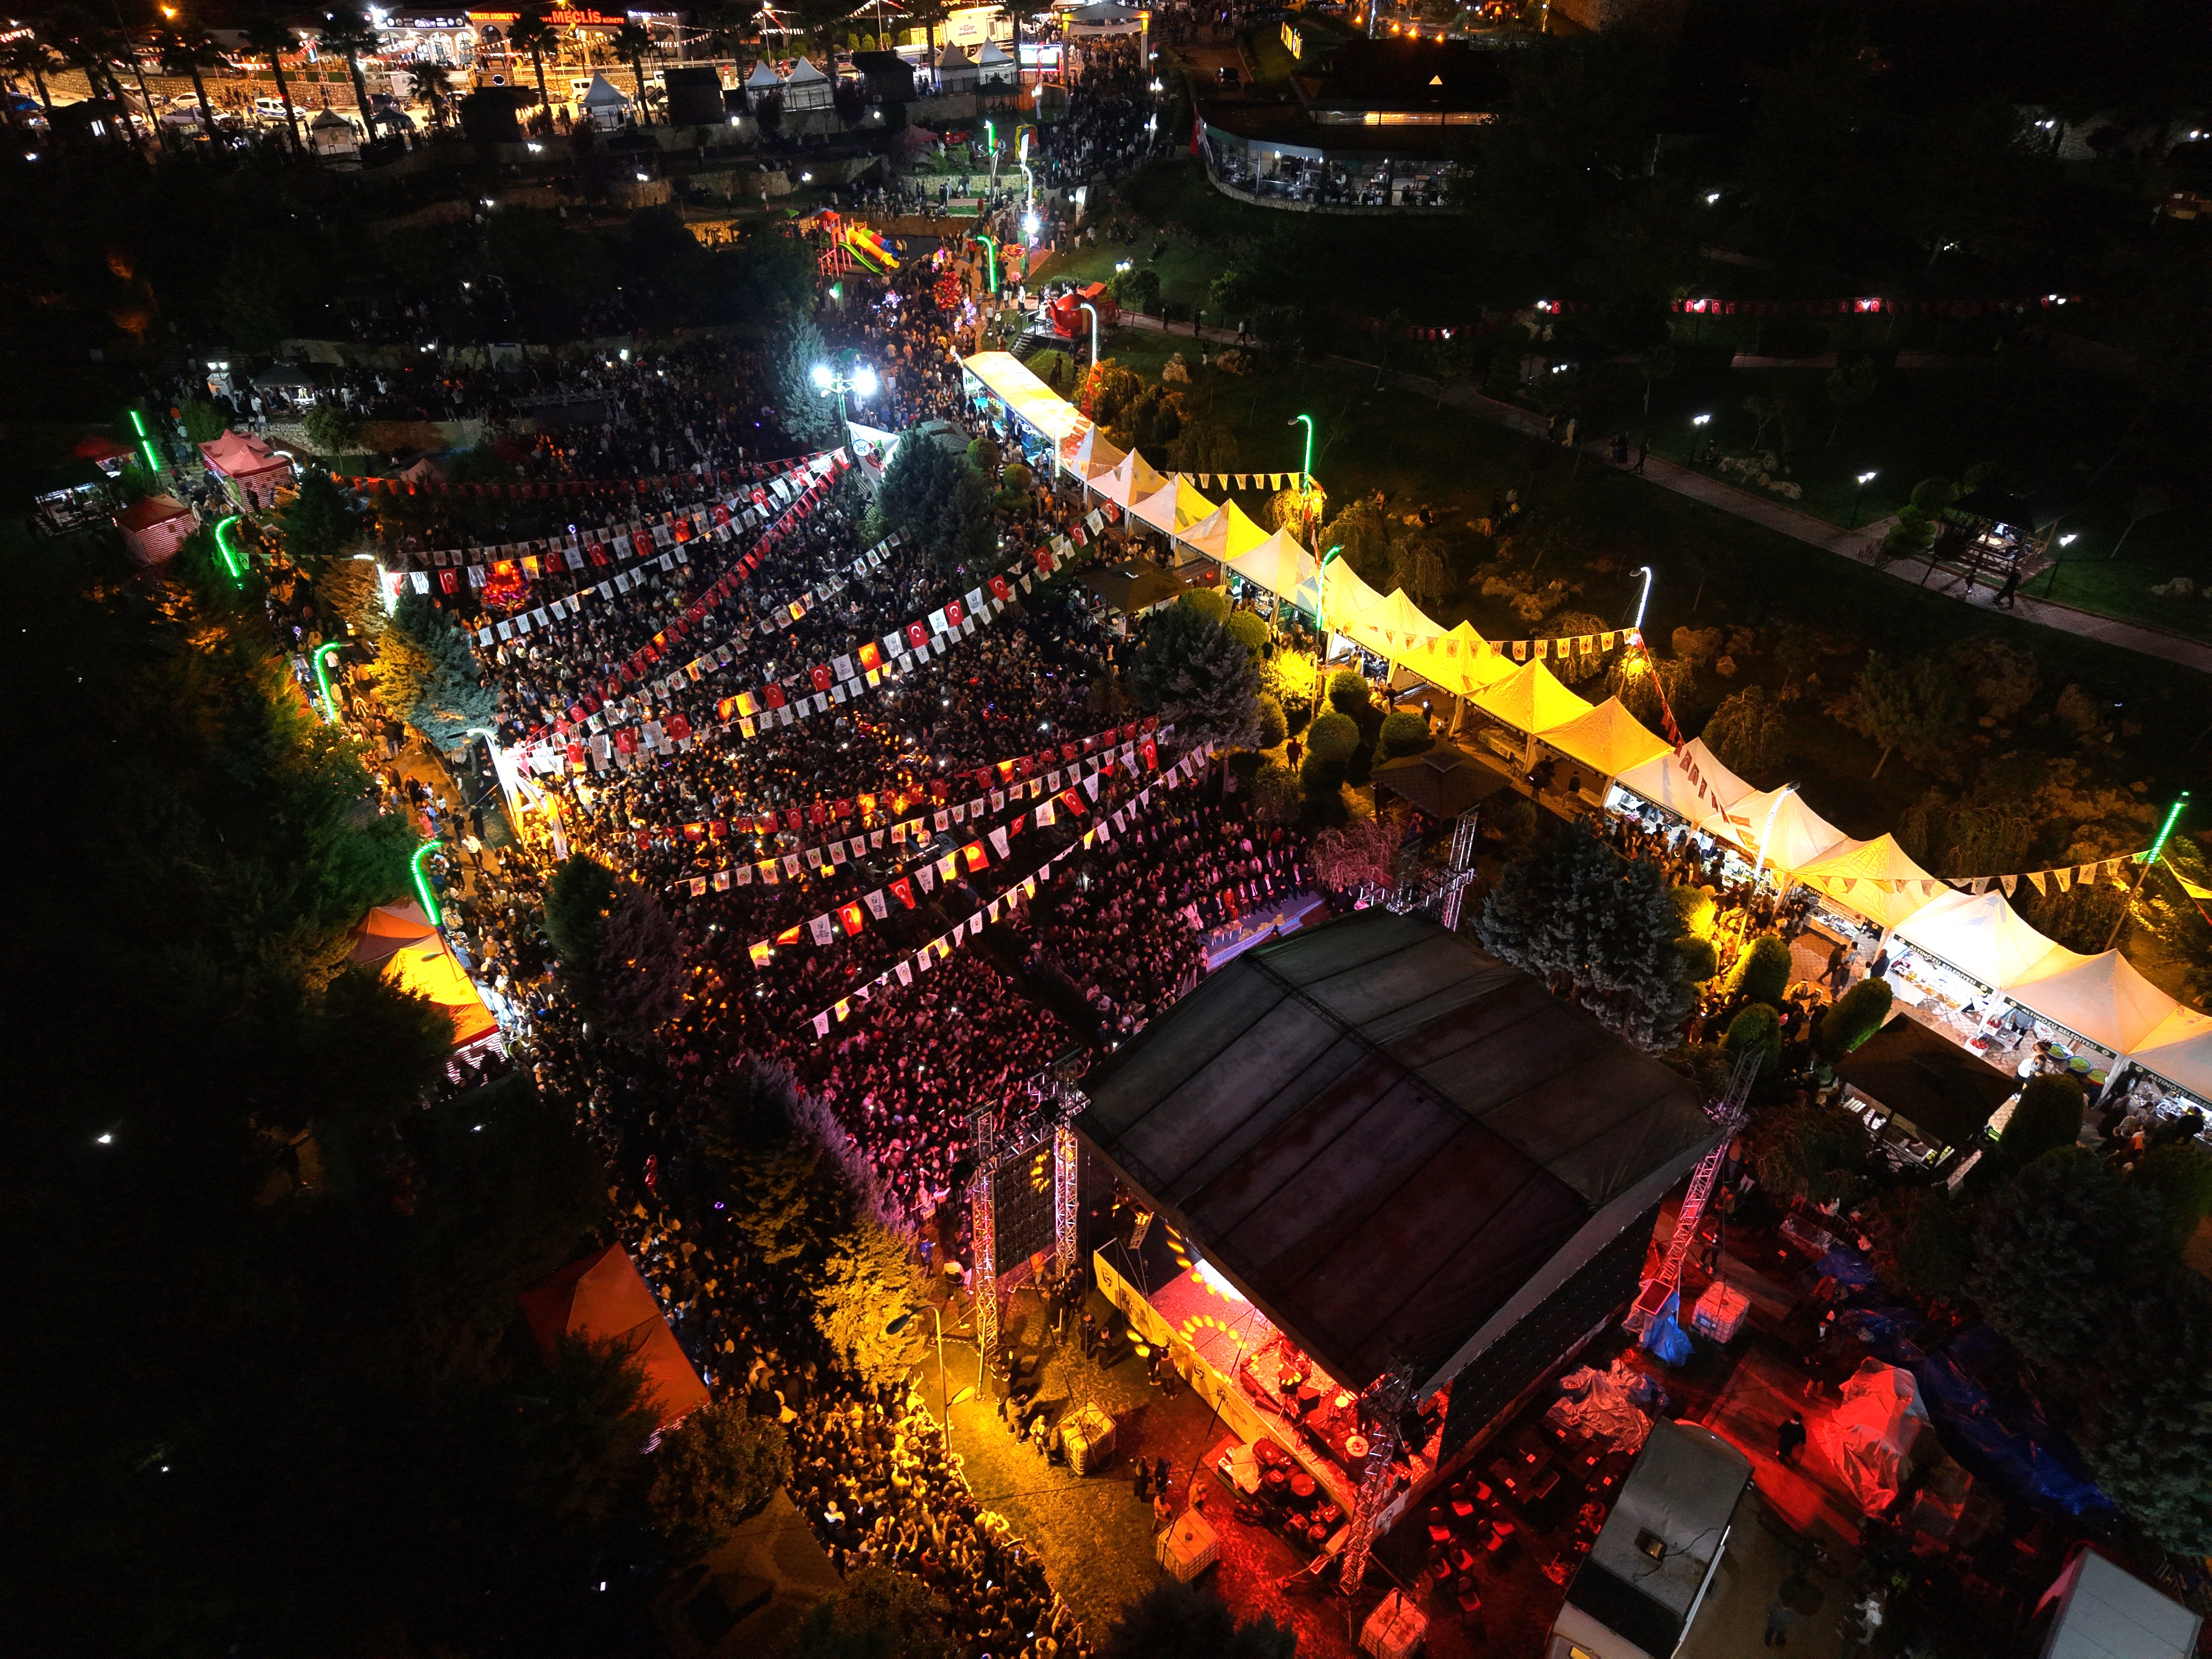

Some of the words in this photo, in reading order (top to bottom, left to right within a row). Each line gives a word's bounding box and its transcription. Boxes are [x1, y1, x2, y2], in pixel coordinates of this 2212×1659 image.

[552, 8, 602, 23] MECLİS
[1909, 945, 1941, 965] ALTINÖZÜ
[2021, 1008, 2058, 1030] ALTINÖZÜ
[2058, 1026, 2098, 1050] BELEDİYESİ
[2148, 1074, 2188, 1096] ALTINÖZÜ
